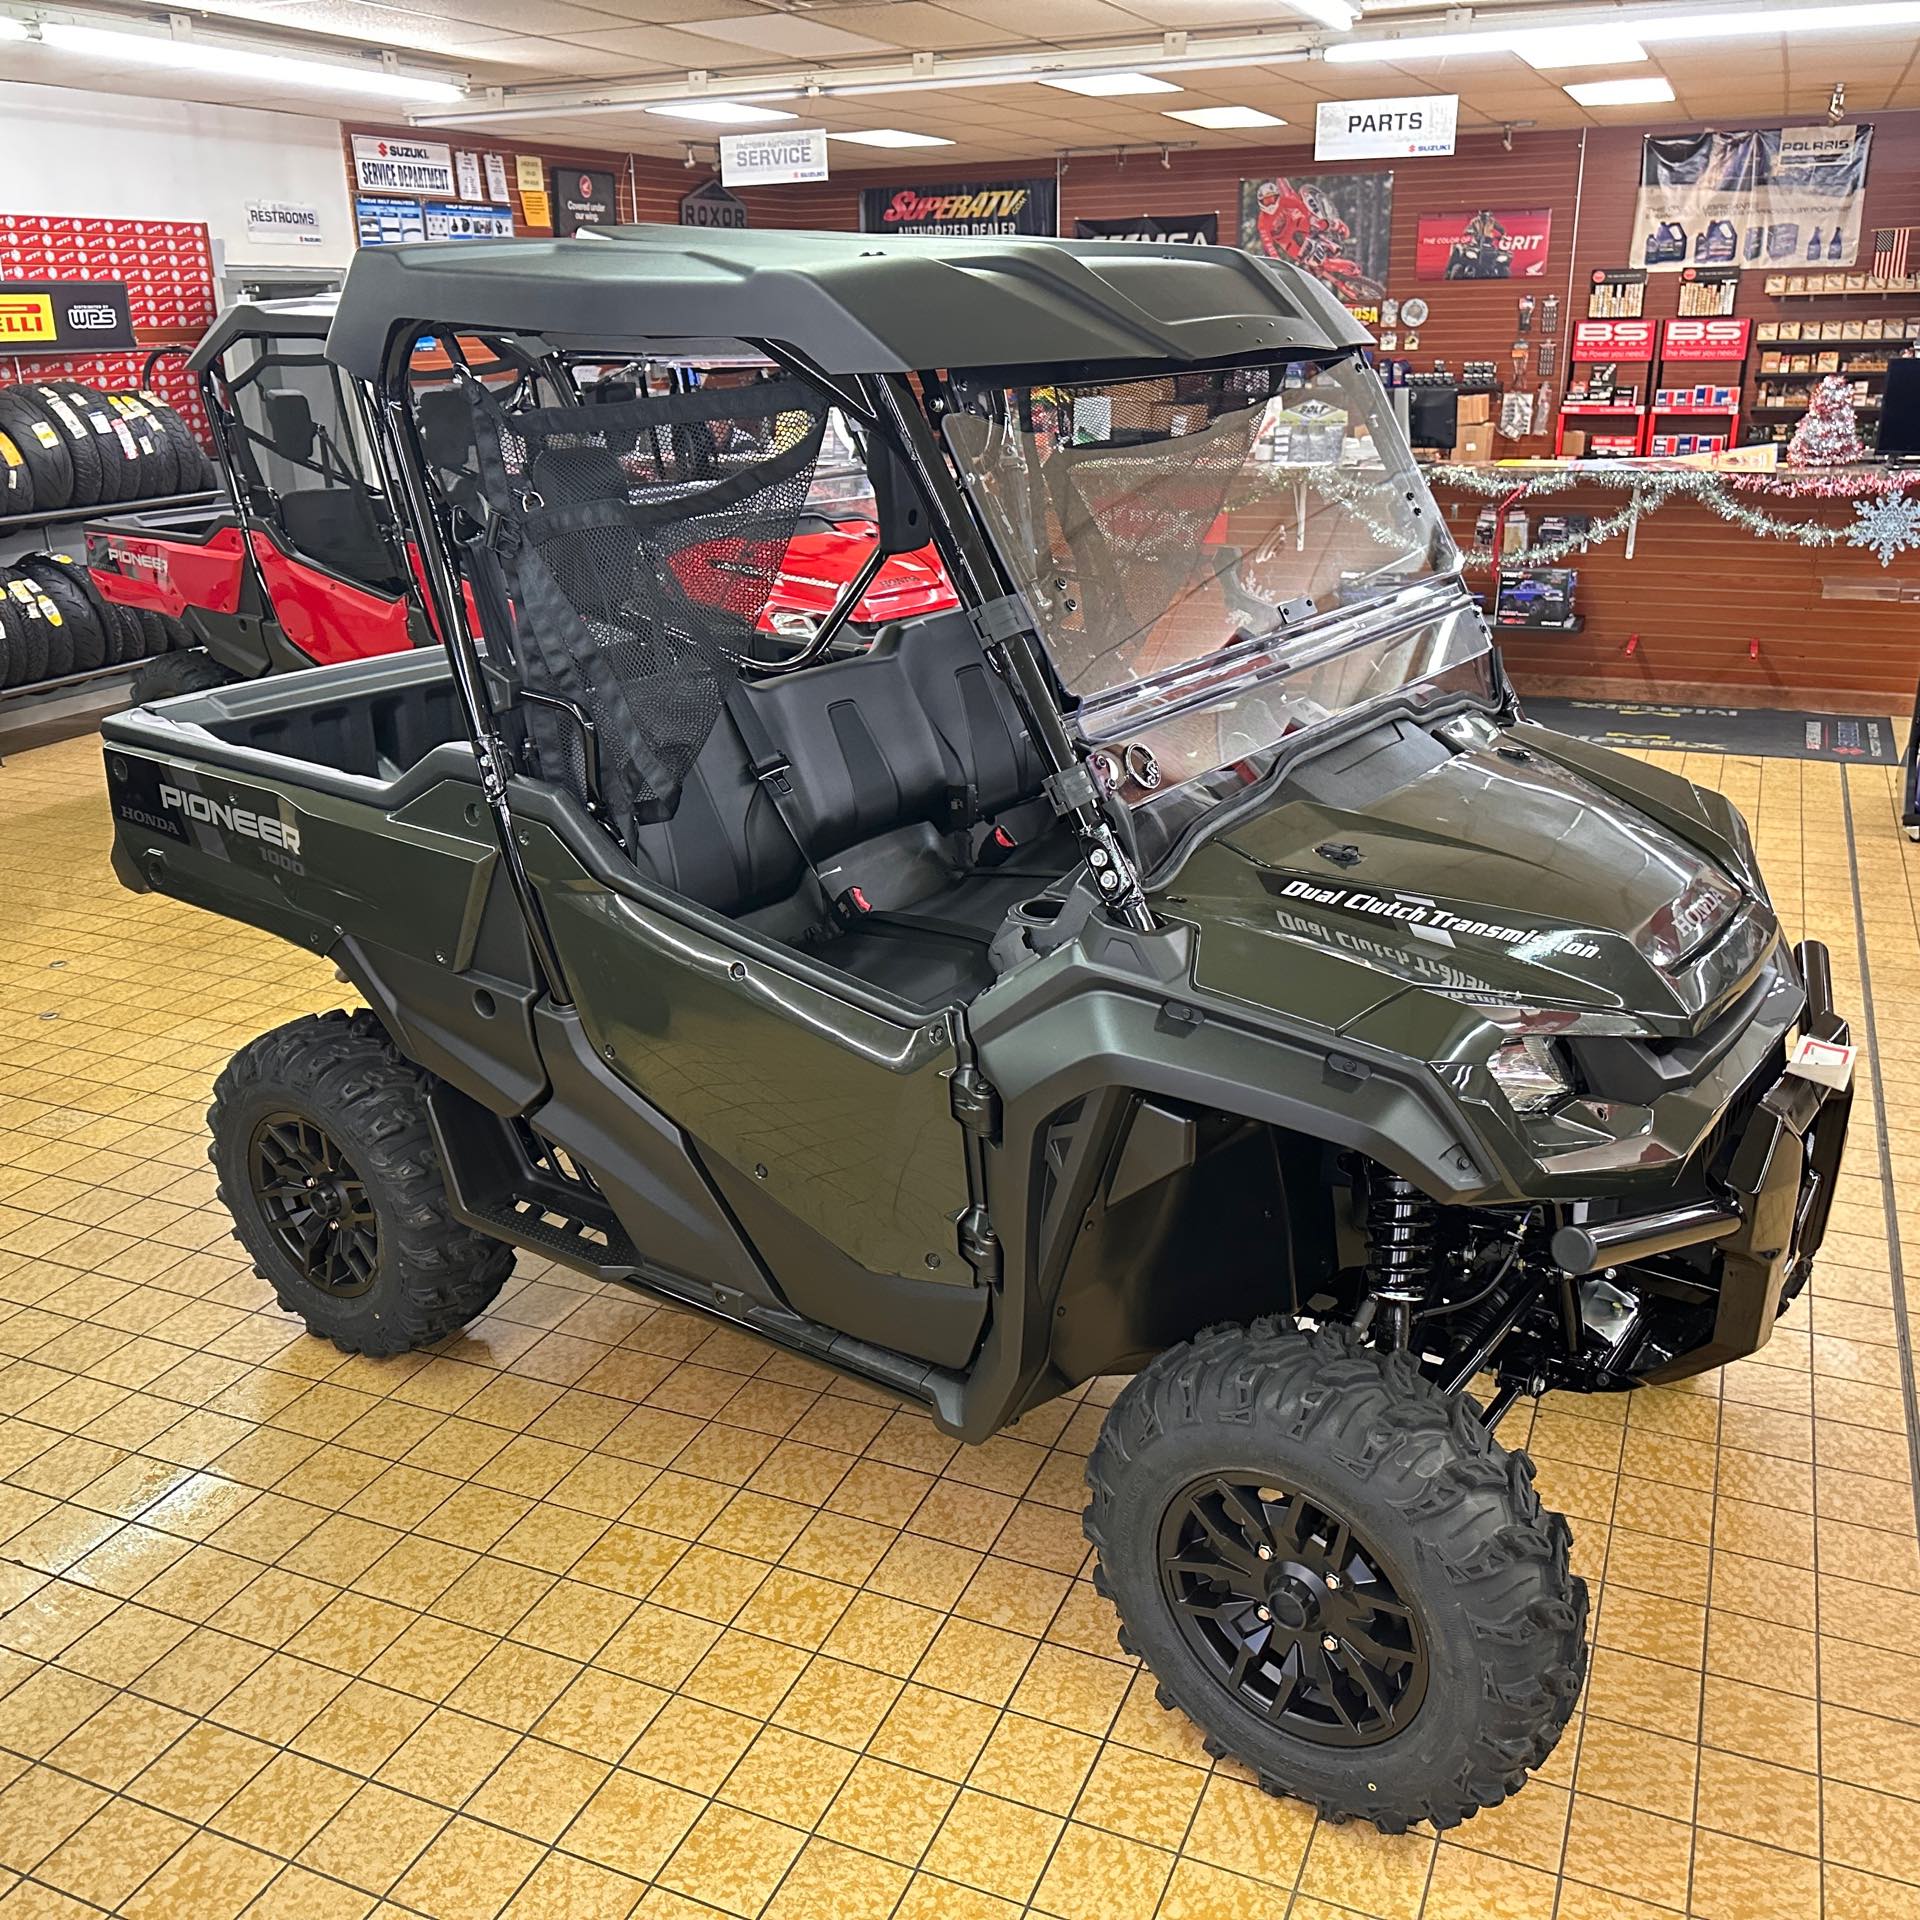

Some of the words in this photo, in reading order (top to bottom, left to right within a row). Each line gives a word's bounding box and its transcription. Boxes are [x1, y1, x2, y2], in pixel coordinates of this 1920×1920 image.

[1348, 112, 1423, 133] PARTS
[389, 145, 428, 159] SUZUKI
[1418, 144, 1450, 152] SUZUKI
[1782, 140, 1849, 152] POLARIS
[736, 146, 812, 167] SERVICE
[362, 161, 398, 187] SERVICE
[397, 165, 450, 190] DEPARTMENT
[567, 201, 590, 212] Covered
[590, 203, 606, 212] under
[575, 212, 585, 220] our
[685, 205, 746, 227] ROXOR
[250, 210, 315, 225] RESTROOMS
[898, 223, 969, 235] AUTHORIZED
[972, 222, 1016, 235] DEALER
[1436, 237, 1461, 245] COLOR
[1499, 235, 1545, 251] GRIT
[68, 309, 117, 329] WPS
[1577, 322, 1649, 342] BS
[1667, 321, 1742, 340] BS
[1299, 404, 1329, 415] BOLT
[108, 548, 168, 575] PIONEER
[777, 571, 839, 590] Transmission
[879, 574, 920, 588] HONDA
[121, 806, 181, 836] HONDA
[159, 783, 301, 857] PIONEER
[258, 846, 306, 876] 1000
[1280, 880, 1347, 906] Dual
[1344, 893, 1431, 926] Clutch
[1429, 909, 1601, 959] Transmiion
[1671, 887, 1726, 937] HONDA
